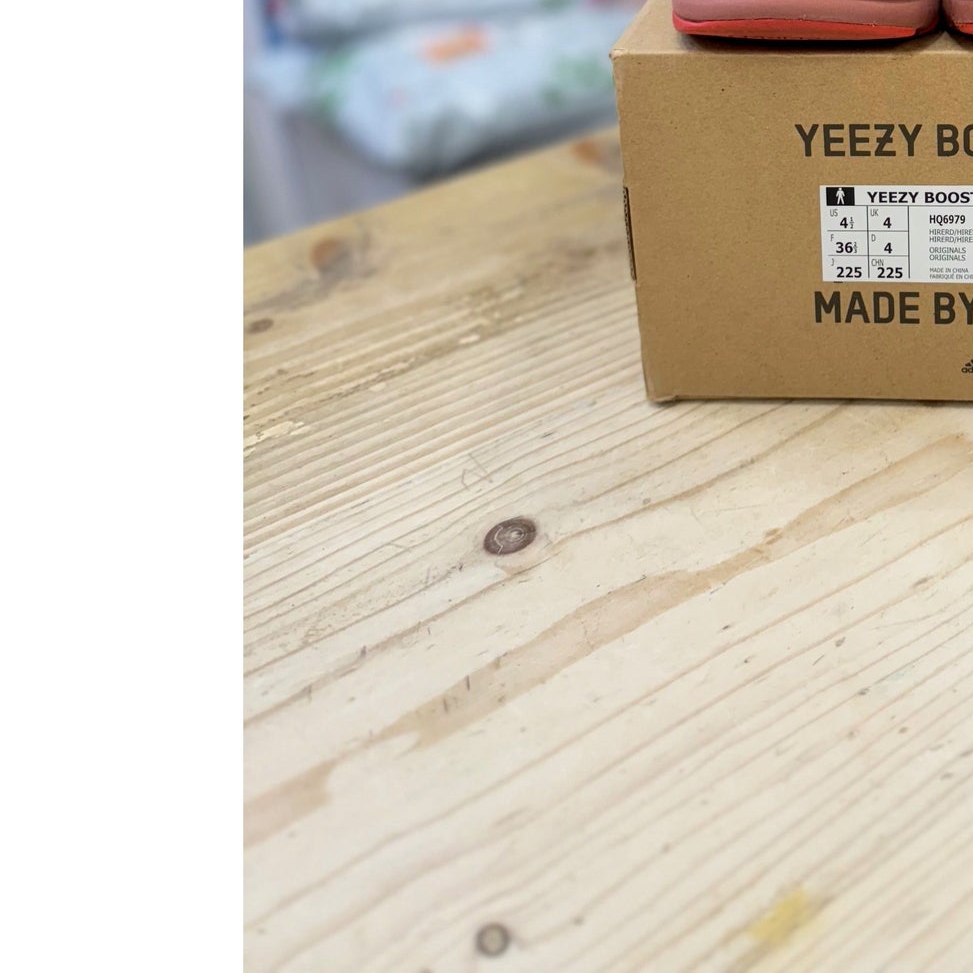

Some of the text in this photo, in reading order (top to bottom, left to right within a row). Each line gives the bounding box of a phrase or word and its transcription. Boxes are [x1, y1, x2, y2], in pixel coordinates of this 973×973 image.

[795, 124, 922, 157] YEEZY
[867, 192, 919, 203] YEEZY
[829, 208, 838, 217] US
[870, 208, 879, 217] UK
[883, 217, 892, 229] 4
[929, 214, 966, 226] HQ6979
[830, 233, 835, 242] F
[871, 233, 876, 242] D
[884, 242, 892, 254] 4
[871, 258, 884, 267] CHN
[836, 267, 862, 278] 225
[877, 267, 903, 278] 225
[814, 291, 920, 324] MADE
